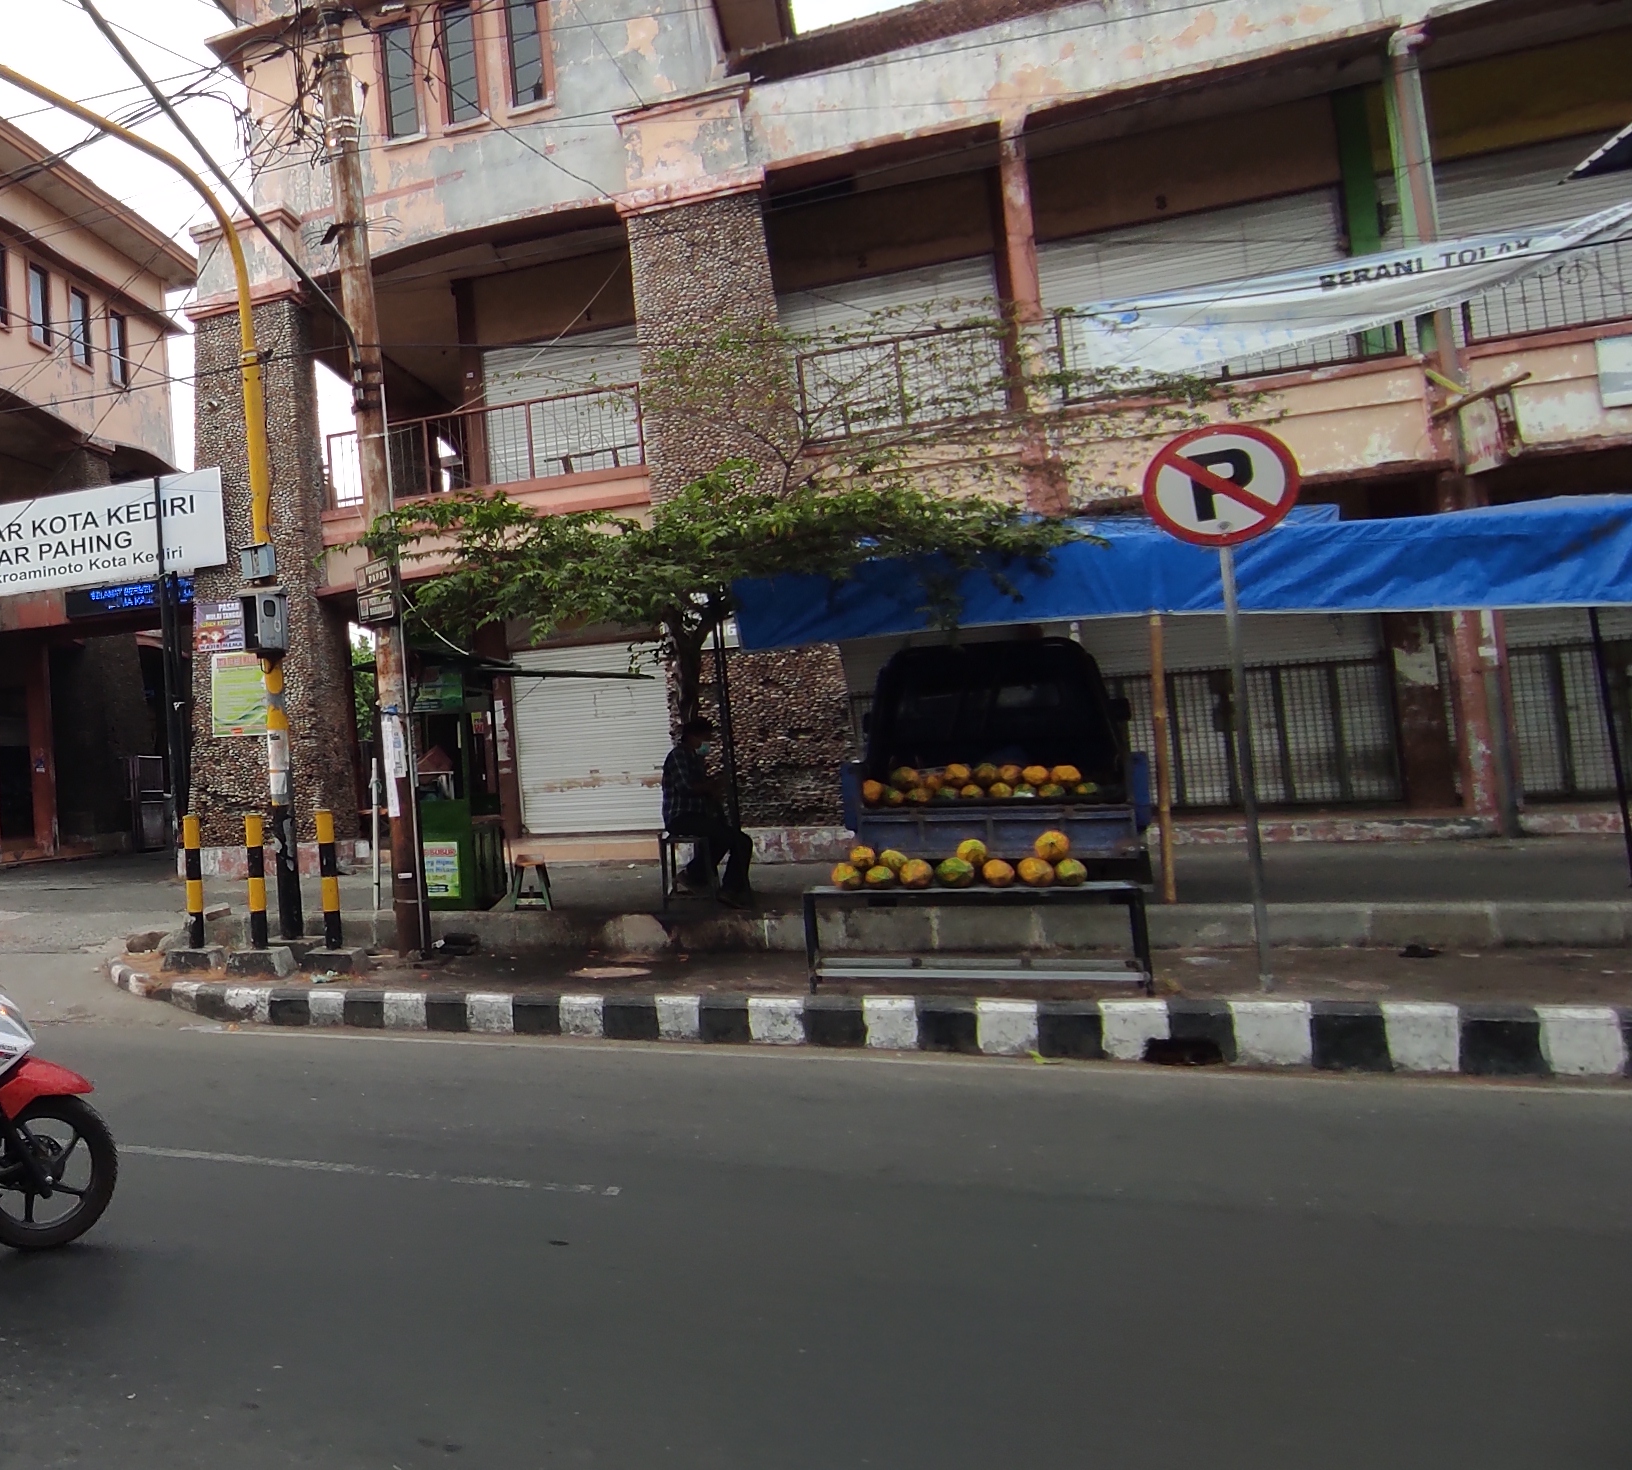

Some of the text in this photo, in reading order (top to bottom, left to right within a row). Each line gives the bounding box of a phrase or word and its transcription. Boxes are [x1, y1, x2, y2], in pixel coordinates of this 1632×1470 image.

[1319, 257, 1422, 290] BERANI
[1186, 448, 1254, 522] P
[32, 511, 99, 538] KOTA
[107, 494, 195, 527] KEDIRI
[39, 530, 132, 562] PAHING
[89, 555, 127, 571] Kota
